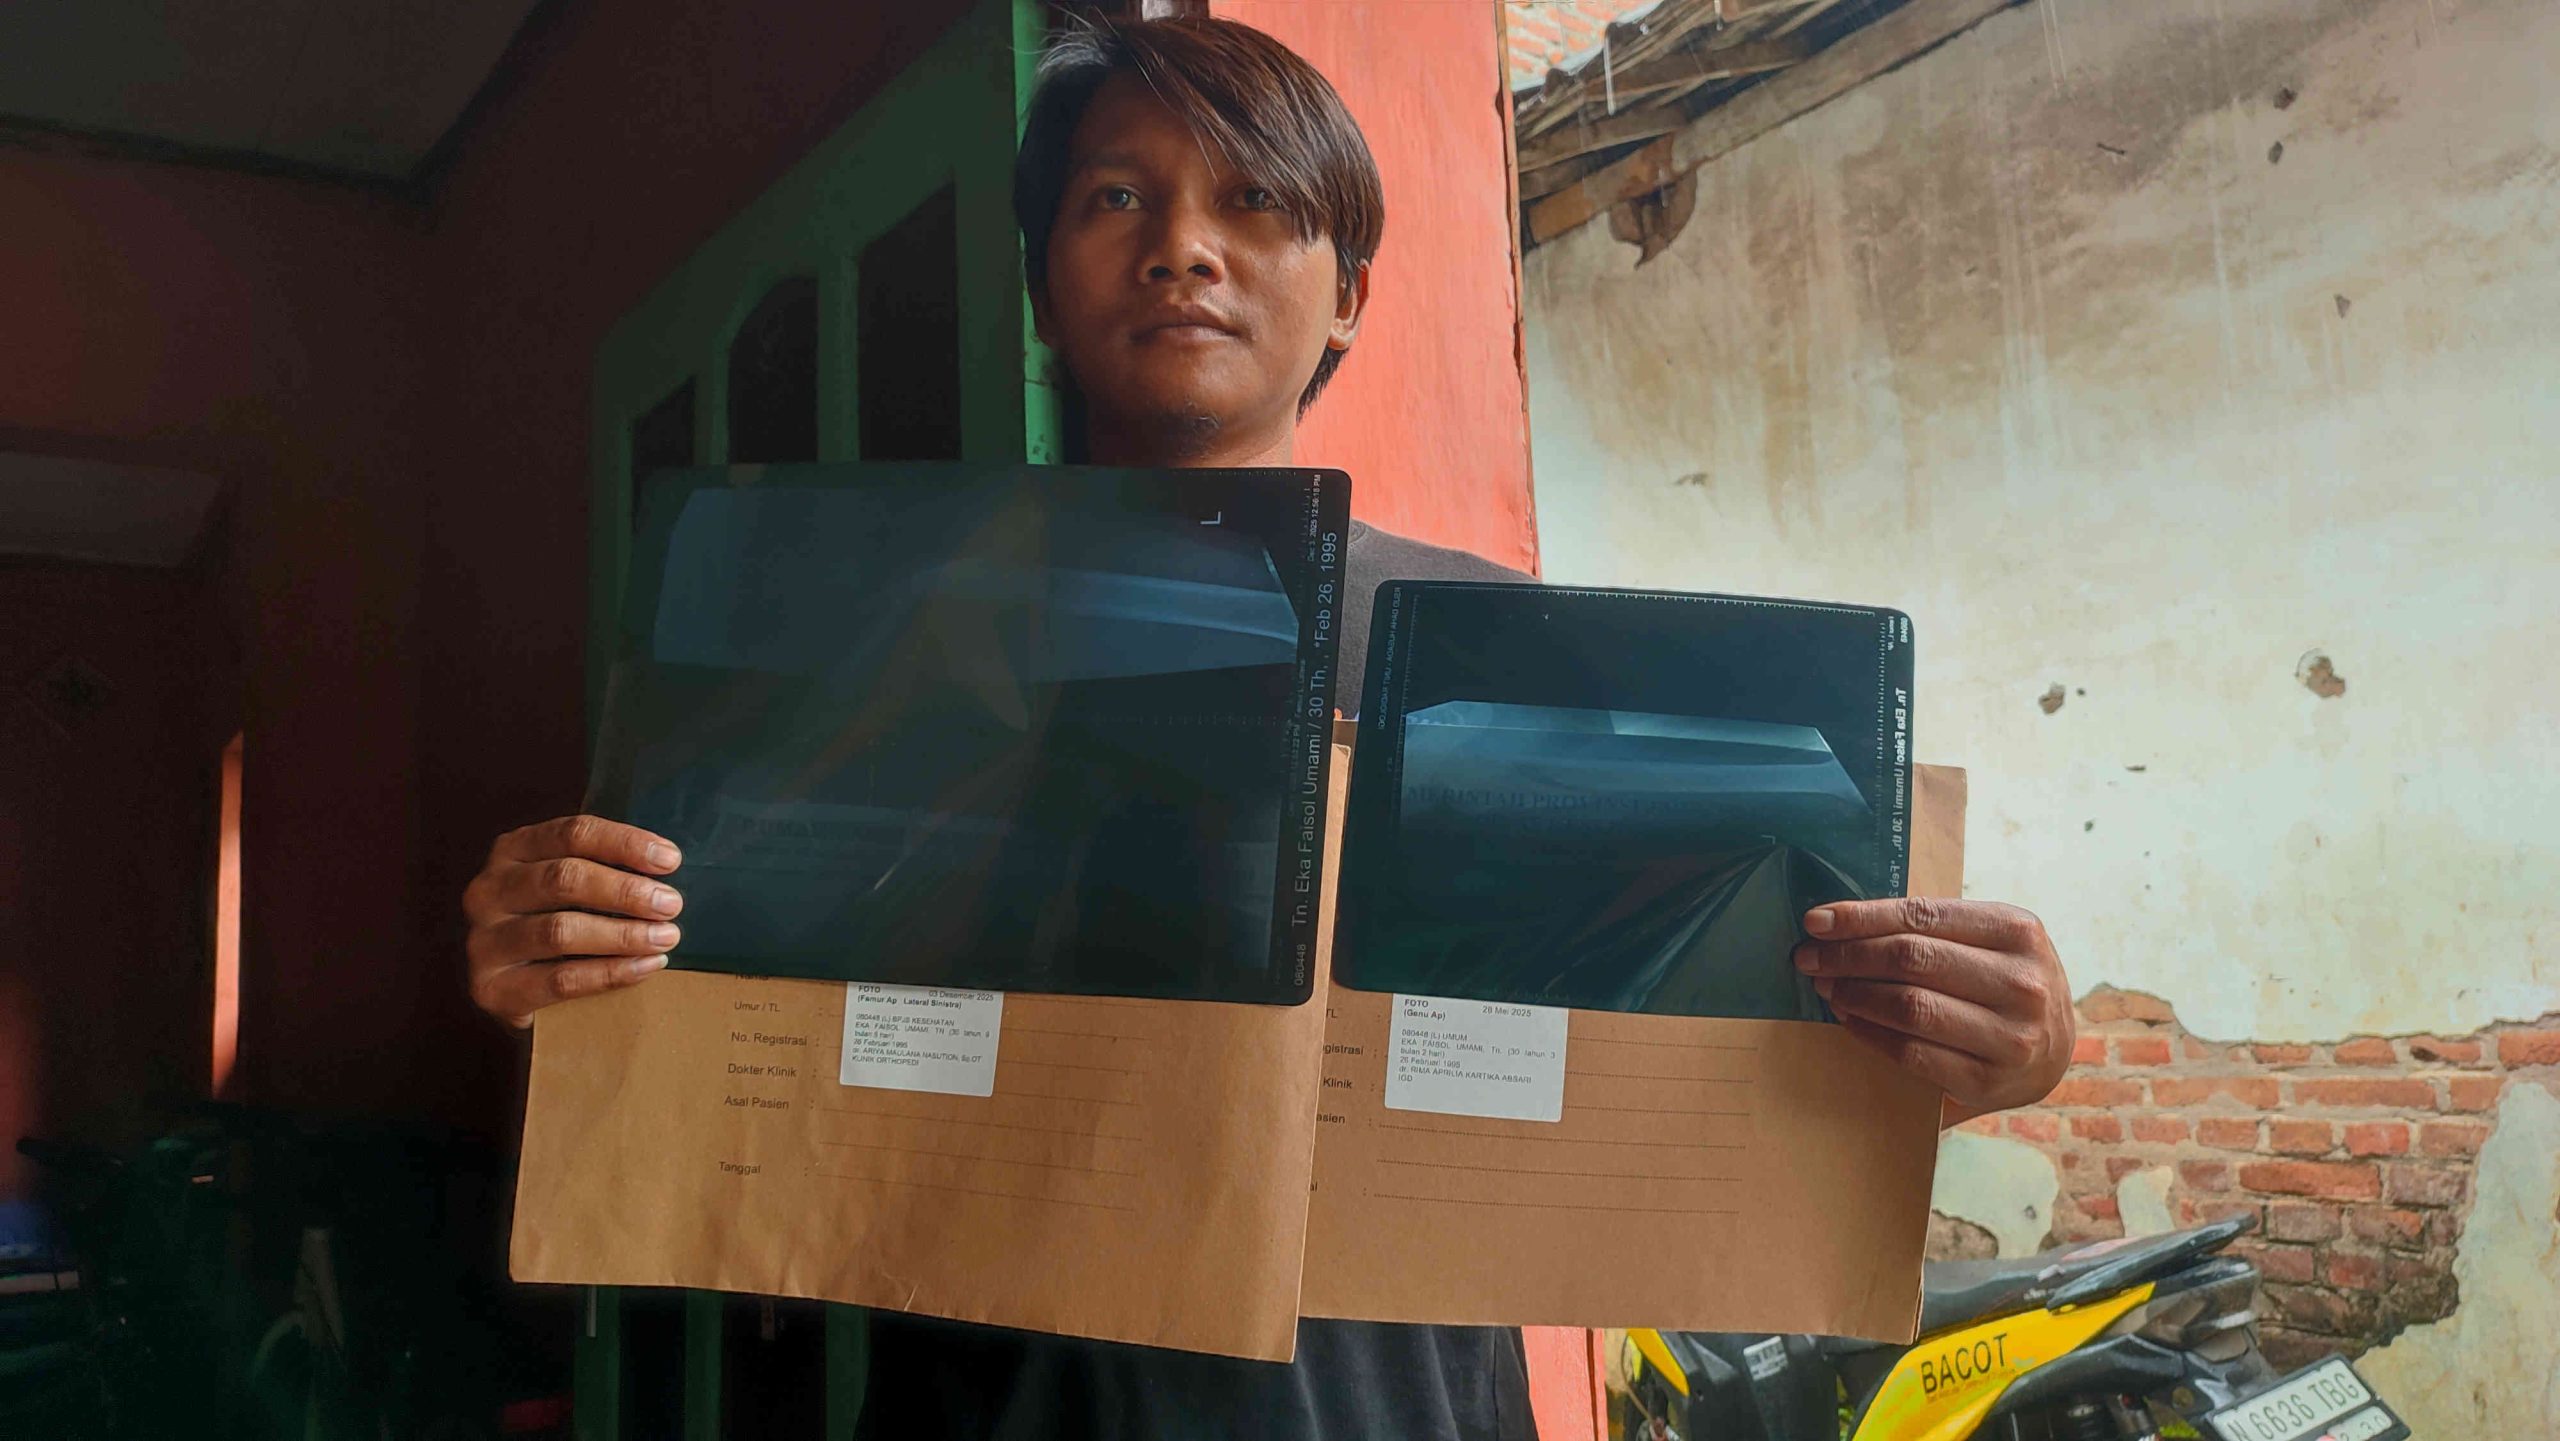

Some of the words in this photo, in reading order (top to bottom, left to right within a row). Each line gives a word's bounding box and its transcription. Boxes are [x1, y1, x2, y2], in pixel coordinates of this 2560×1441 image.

[1314, 474, 1321, 486] PM
[1320, 532, 1337, 572] 1995
[1318, 579, 1336, 605] 26,
[1308, 696, 1324, 718] 30
[1302, 734, 1321, 795] Umami
[1297, 801, 1317, 853] Faisol
[1294, 859, 1312, 893] Eka
[1291, 900, 1308, 927] Tn.
[1294, 943, 1307, 987] 080448
[858, 985, 881, 993] FOTO
[734, 1000, 760, 1012] Umur
[768, 1002, 781, 1012] TL
[1404, 998, 1429, 1008] FOTO
[1511, 1008, 1532, 1017] 2025
[1403, 1008, 1429, 1018] (Genu
[1430, 1010, 1446, 1021] Ap)
[753, 1032, 808, 1047] Registrasi
[1401, 1037, 1418, 1046] EKA
[1422, 1039, 1451, 1049] FAISOL
[1442, 1032, 1468, 1042] UMUM
[1399, 1047, 1420, 1056] bulan
[728, 1063, 763, 1077] Dokter
[766, 1065, 798, 1078] Klinik
[1410, 1066, 1431, 1075] RIMA
[1432, 1067, 1464, 1078] APRILIA
[1465, 1070, 1500, 1081] KARTIKA
[1501, 1073, 1532, 1084] ABSARI
[1323, 1076, 1353, 1089] Klinik
[724, 1095, 750, 1108] Asal
[752, 1096, 790, 1110] Pasien
[1316, 1113, 1346, 1125] asien
[718, 1160, 761, 1175] Tanggal
[1920, 1332, 2008, 1395] BACOT
[2227, 1419, 2252, 1441] N
[2248, 1393, 2316, 1440] 6636
[2307, 1372, 2361, 1412] TBG
